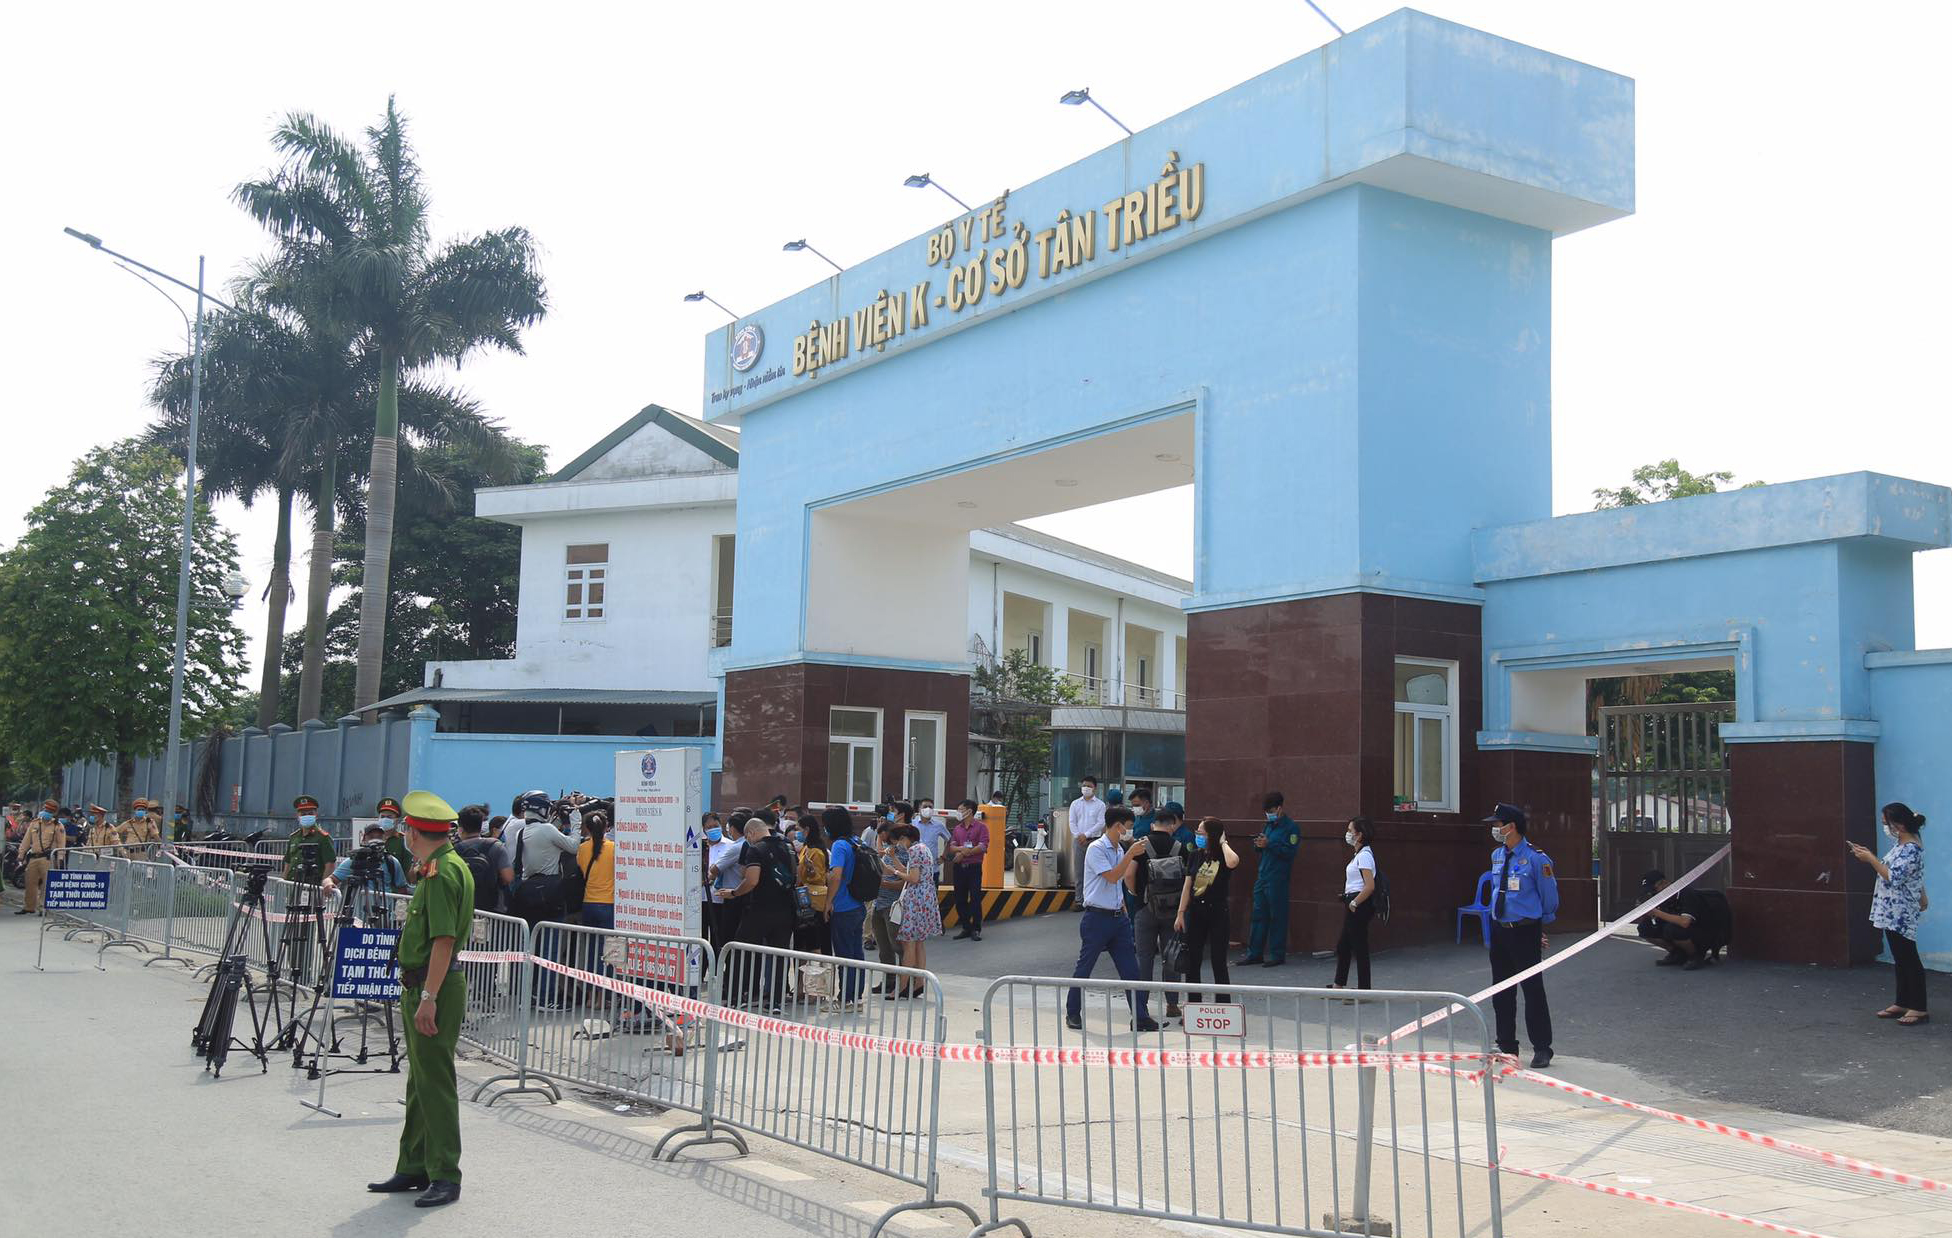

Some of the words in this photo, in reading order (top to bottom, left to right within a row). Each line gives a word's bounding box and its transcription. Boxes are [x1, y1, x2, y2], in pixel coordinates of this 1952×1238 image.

[926, 222, 957, 269] BỘ
[961, 216, 975, 252] Y
[979, 188, 1010, 243] TẾ
[792, 319, 850, 380] BỆNH
[853, 289, 906, 352] VIỆN
[910, 281, 931, 330] K
[947, 248, 987, 313] CƠ
[990, 221, 1030, 297] SỞ
[1035, 208, 1097, 279] TÂN
[1103, 150, 1206, 252] TRIỀU
[50, 881, 64, 889] DỊCH
[64, 880, 80, 889] BỆNH
[80, 881, 105, 889] COVID-19
[50, 890, 64, 900] TẠM
[65, 889, 81, 899] THỜI
[81, 889, 105, 899] KHÔNG
[362, 933, 374, 945] DO
[376, 932, 396, 946] TÌNH
[344, 948, 366, 961] DỊCH
[367, 946, 391, 962] BỆNH
[342, 965, 366, 980] TẠM
[337, 980, 356, 994] TIẾP
[357, 982, 382, 998] NHẬN
[1196, 1018, 1231, 1030] STOP
